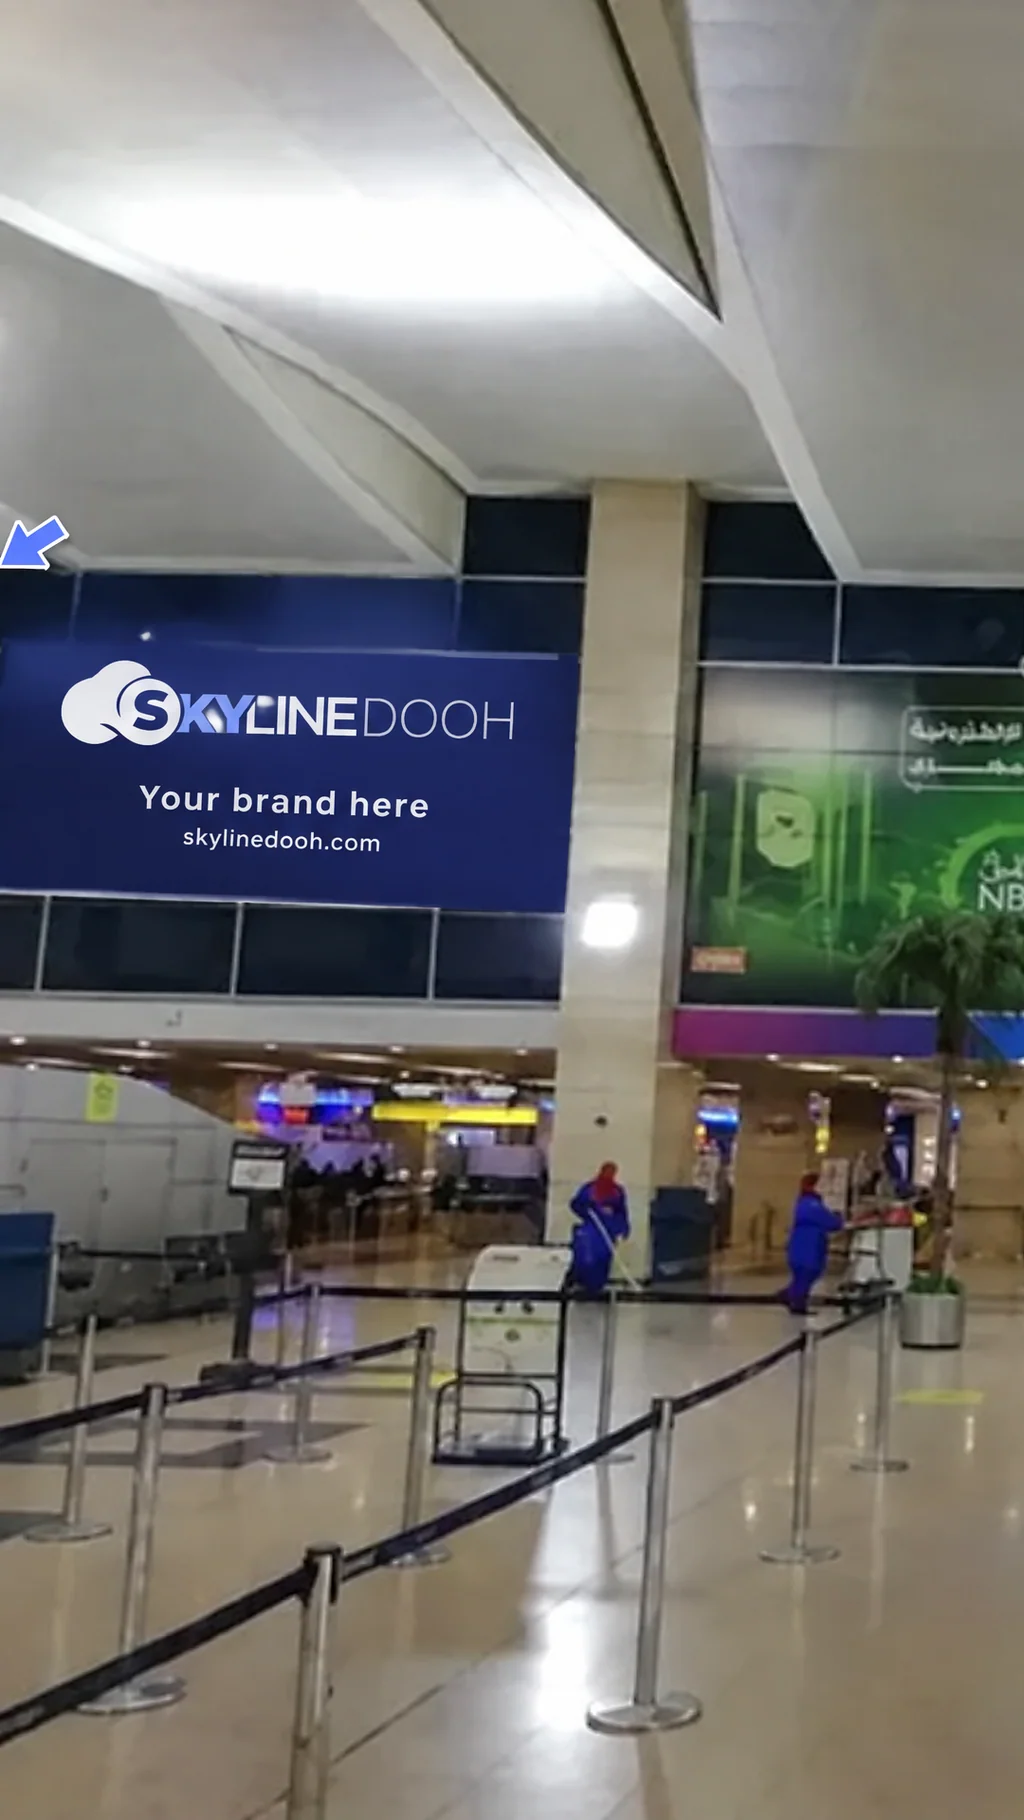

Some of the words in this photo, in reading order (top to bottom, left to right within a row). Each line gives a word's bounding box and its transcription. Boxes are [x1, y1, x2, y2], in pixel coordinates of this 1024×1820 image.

[139, 784, 220, 812] Your
[232, 786, 336, 816] brand
[350, 790, 429, 819] here
[182, 826, 381, 853] skylinedooh.com
